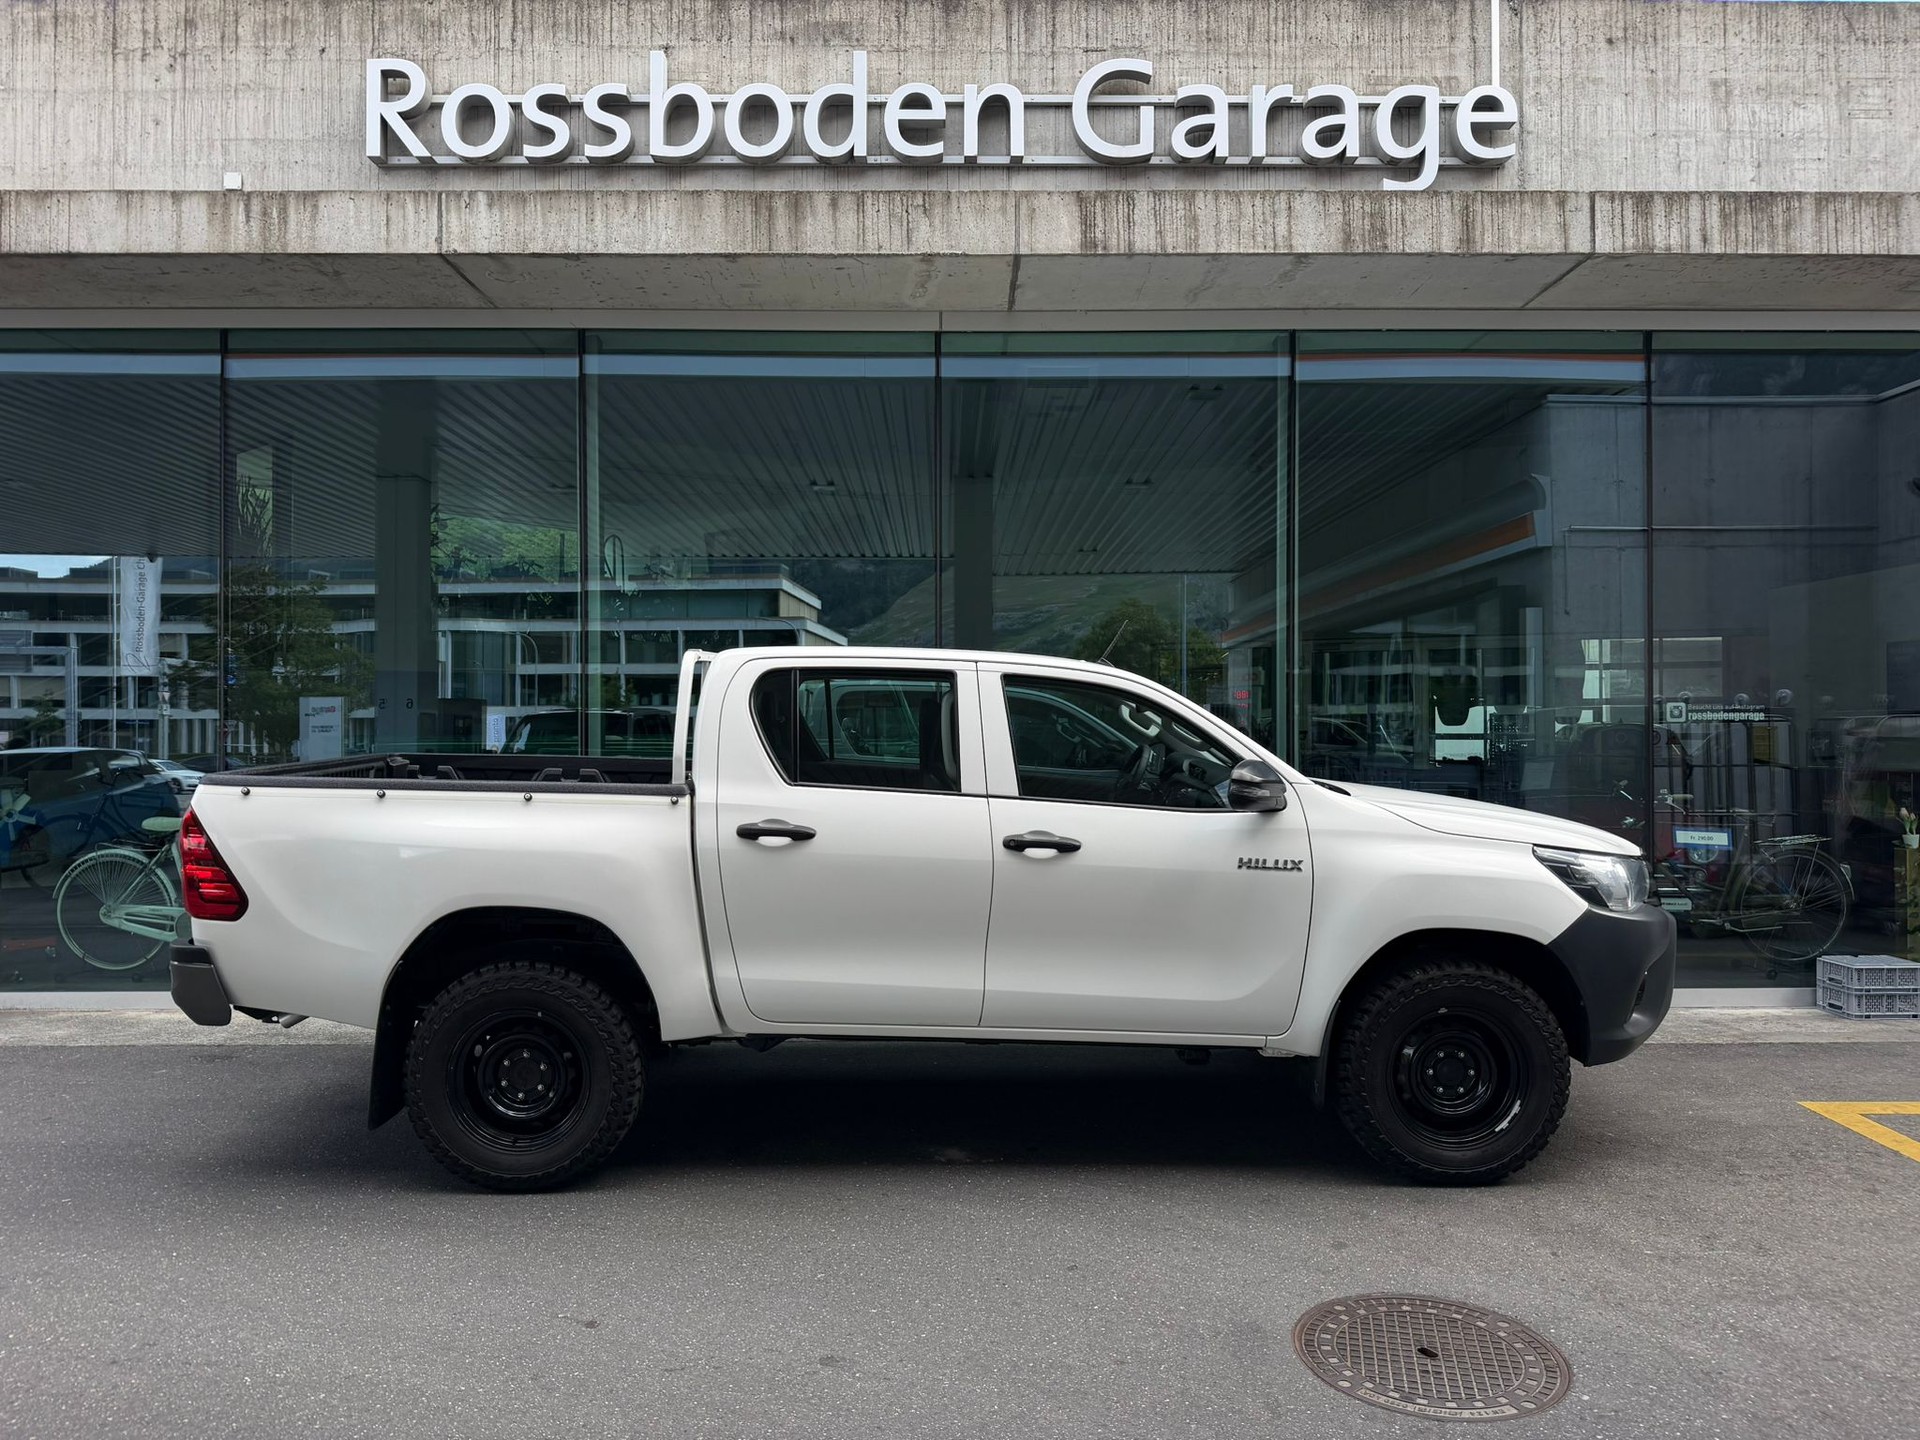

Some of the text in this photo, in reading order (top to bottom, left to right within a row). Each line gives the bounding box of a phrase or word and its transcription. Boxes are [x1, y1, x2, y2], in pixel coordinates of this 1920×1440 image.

[366, 50, 1517, 190] Rossboden Garage
[1688, 711, 1766, 721] rossbodengarage
[1237, 857, 1304, 872] HILUX
